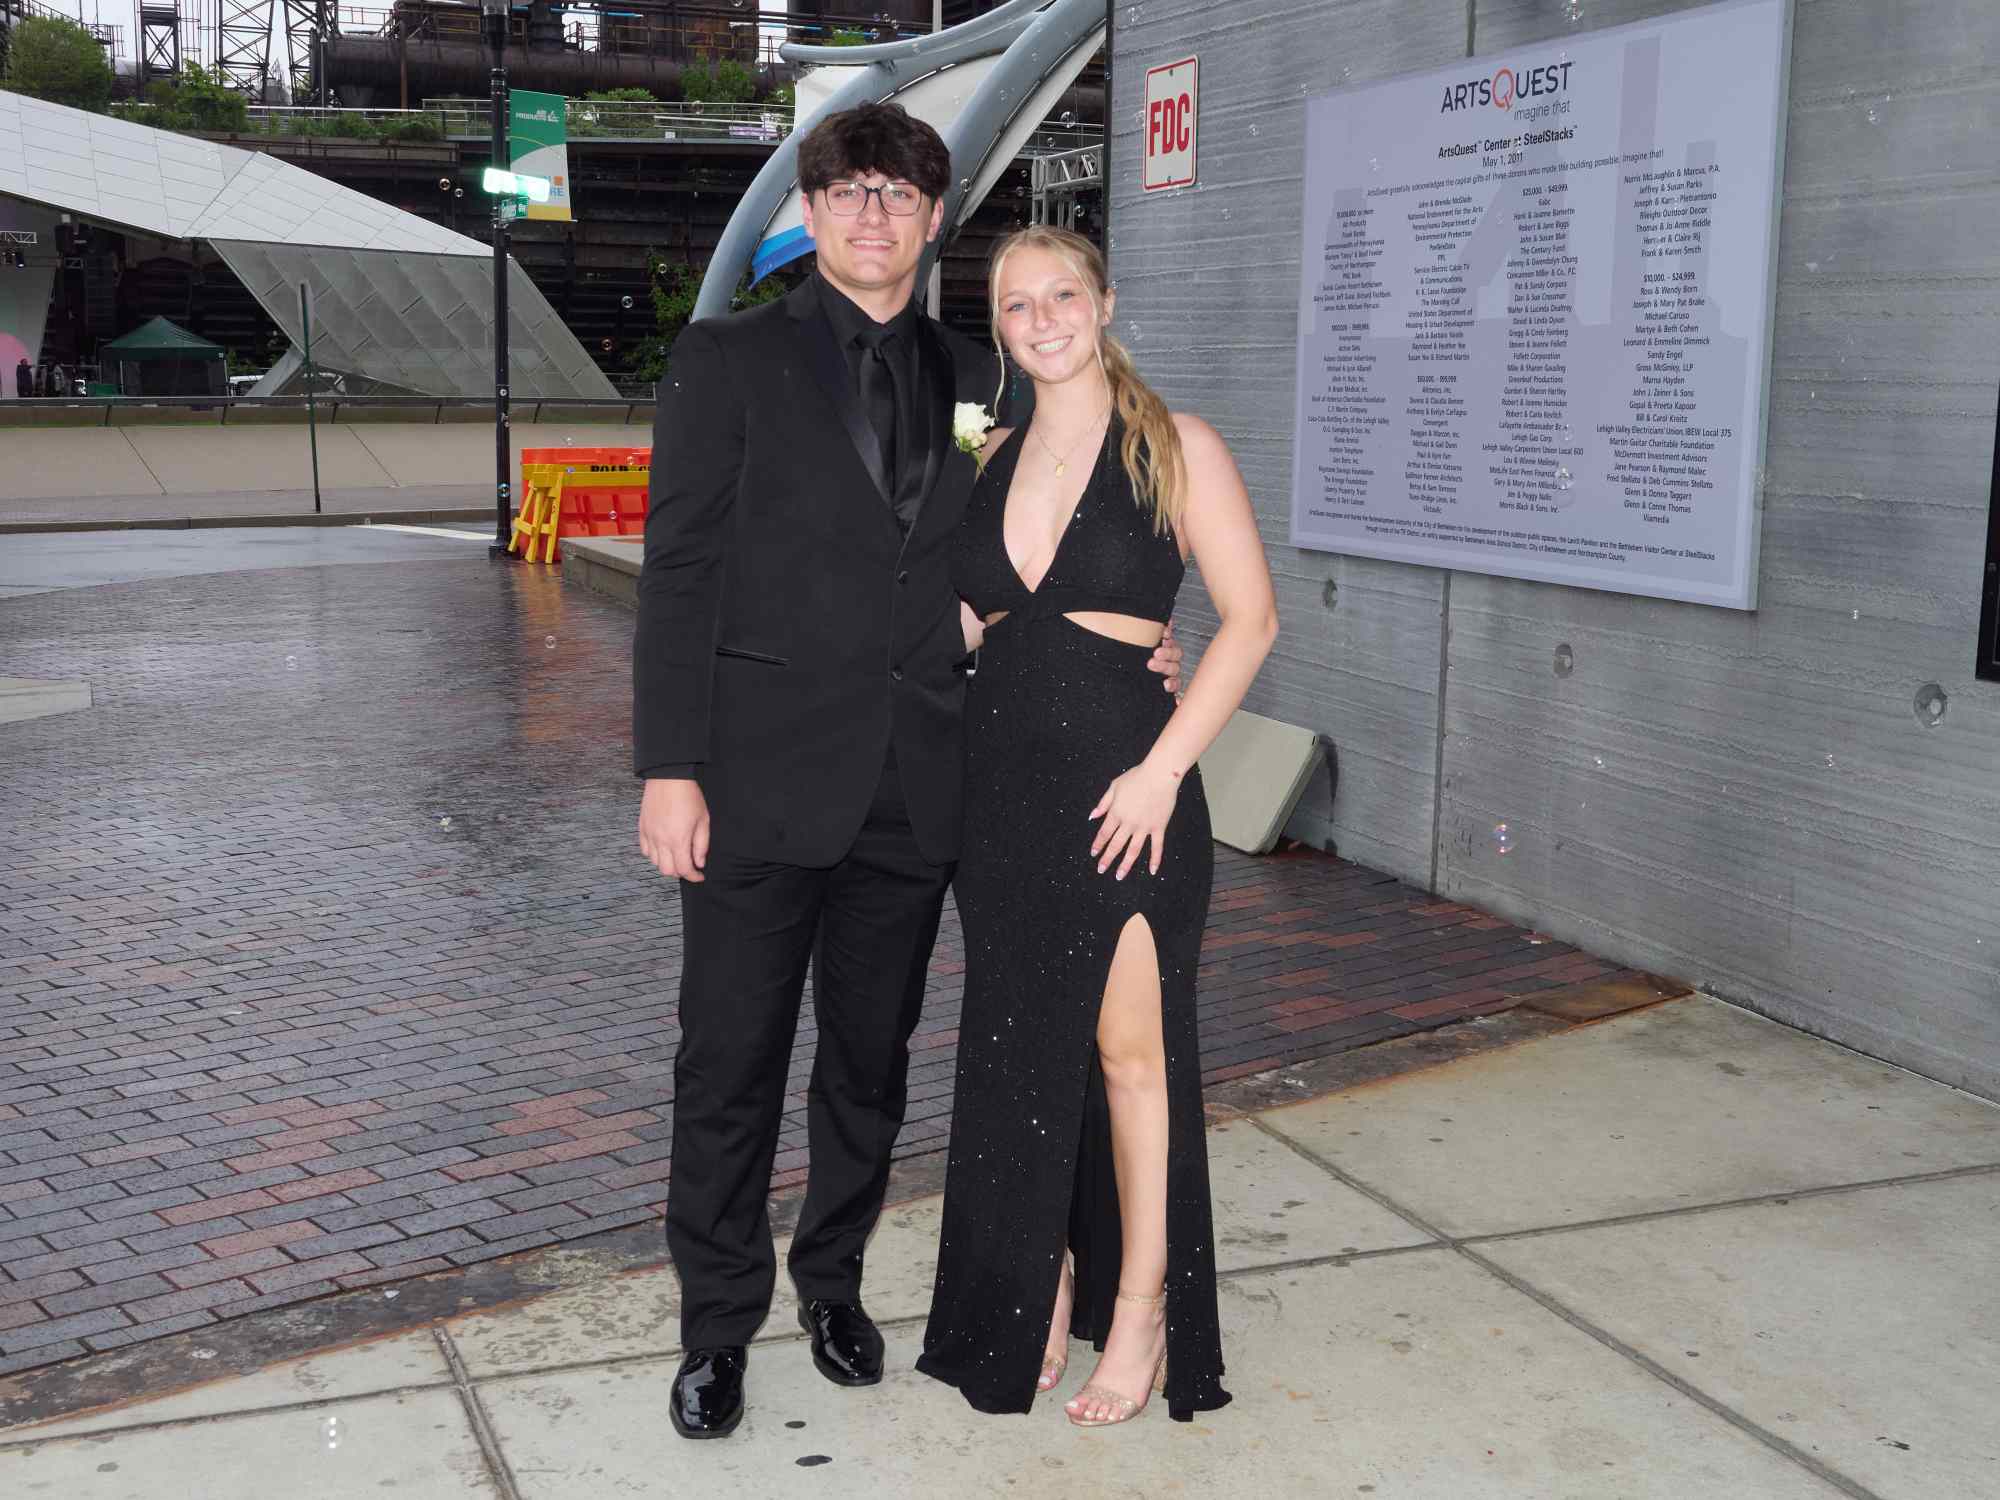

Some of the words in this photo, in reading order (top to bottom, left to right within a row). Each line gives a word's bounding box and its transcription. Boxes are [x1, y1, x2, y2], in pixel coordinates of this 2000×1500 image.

[1441, 62, 1572, 113] ARTSQUEST
[1513, 102, 1549, 124] imagine
[1552, 98, 1570, 115] that
[1149, 92, 1190, 158] FDC
[1484, 135, 1510, 152] Center
[1513, 134, 1521, 147] at
[1482, 155, 1497, 169] May
[1507, 151, 1522, 164] 2011
[1569, 158, 1592, 171] building
